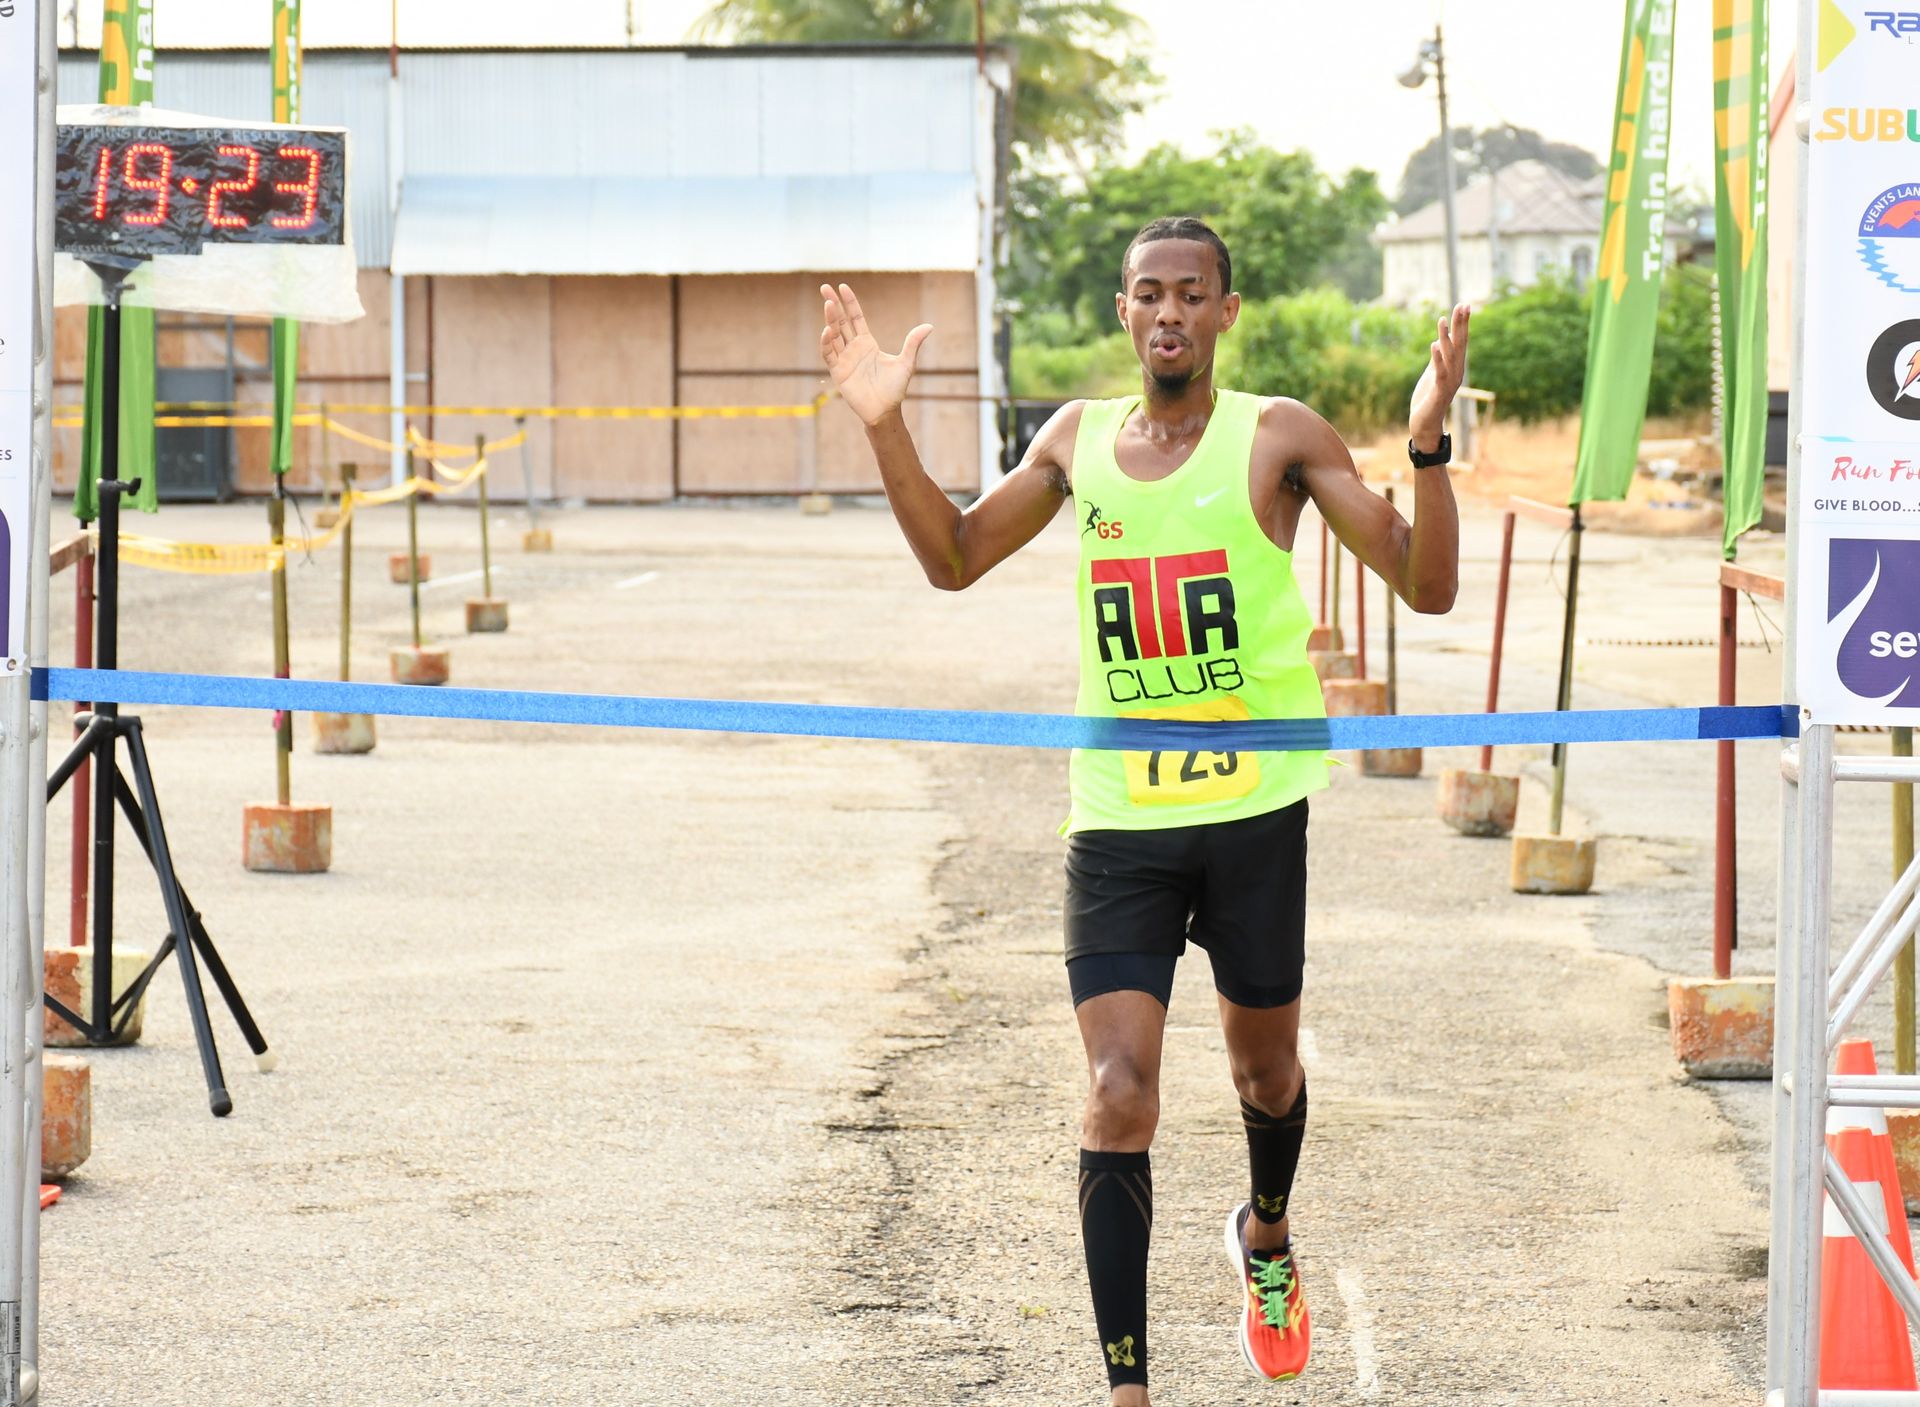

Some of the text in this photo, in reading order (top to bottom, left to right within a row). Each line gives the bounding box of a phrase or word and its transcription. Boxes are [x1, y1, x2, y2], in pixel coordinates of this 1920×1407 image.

[134, 0, 153, 80] ha
[1642, 0, 1673, 281] Train hard. E
[1863, 191, 1896, 232] EVENTS
[1831, 456, 1884, 481] Run
[1814, 499, 1920, 512] GIVE BLOOD...
[1097, 521, 1123, 540] GS
[1869, 630, 1920, 658] se
[1107, 657, 1245, 703] CLUB
